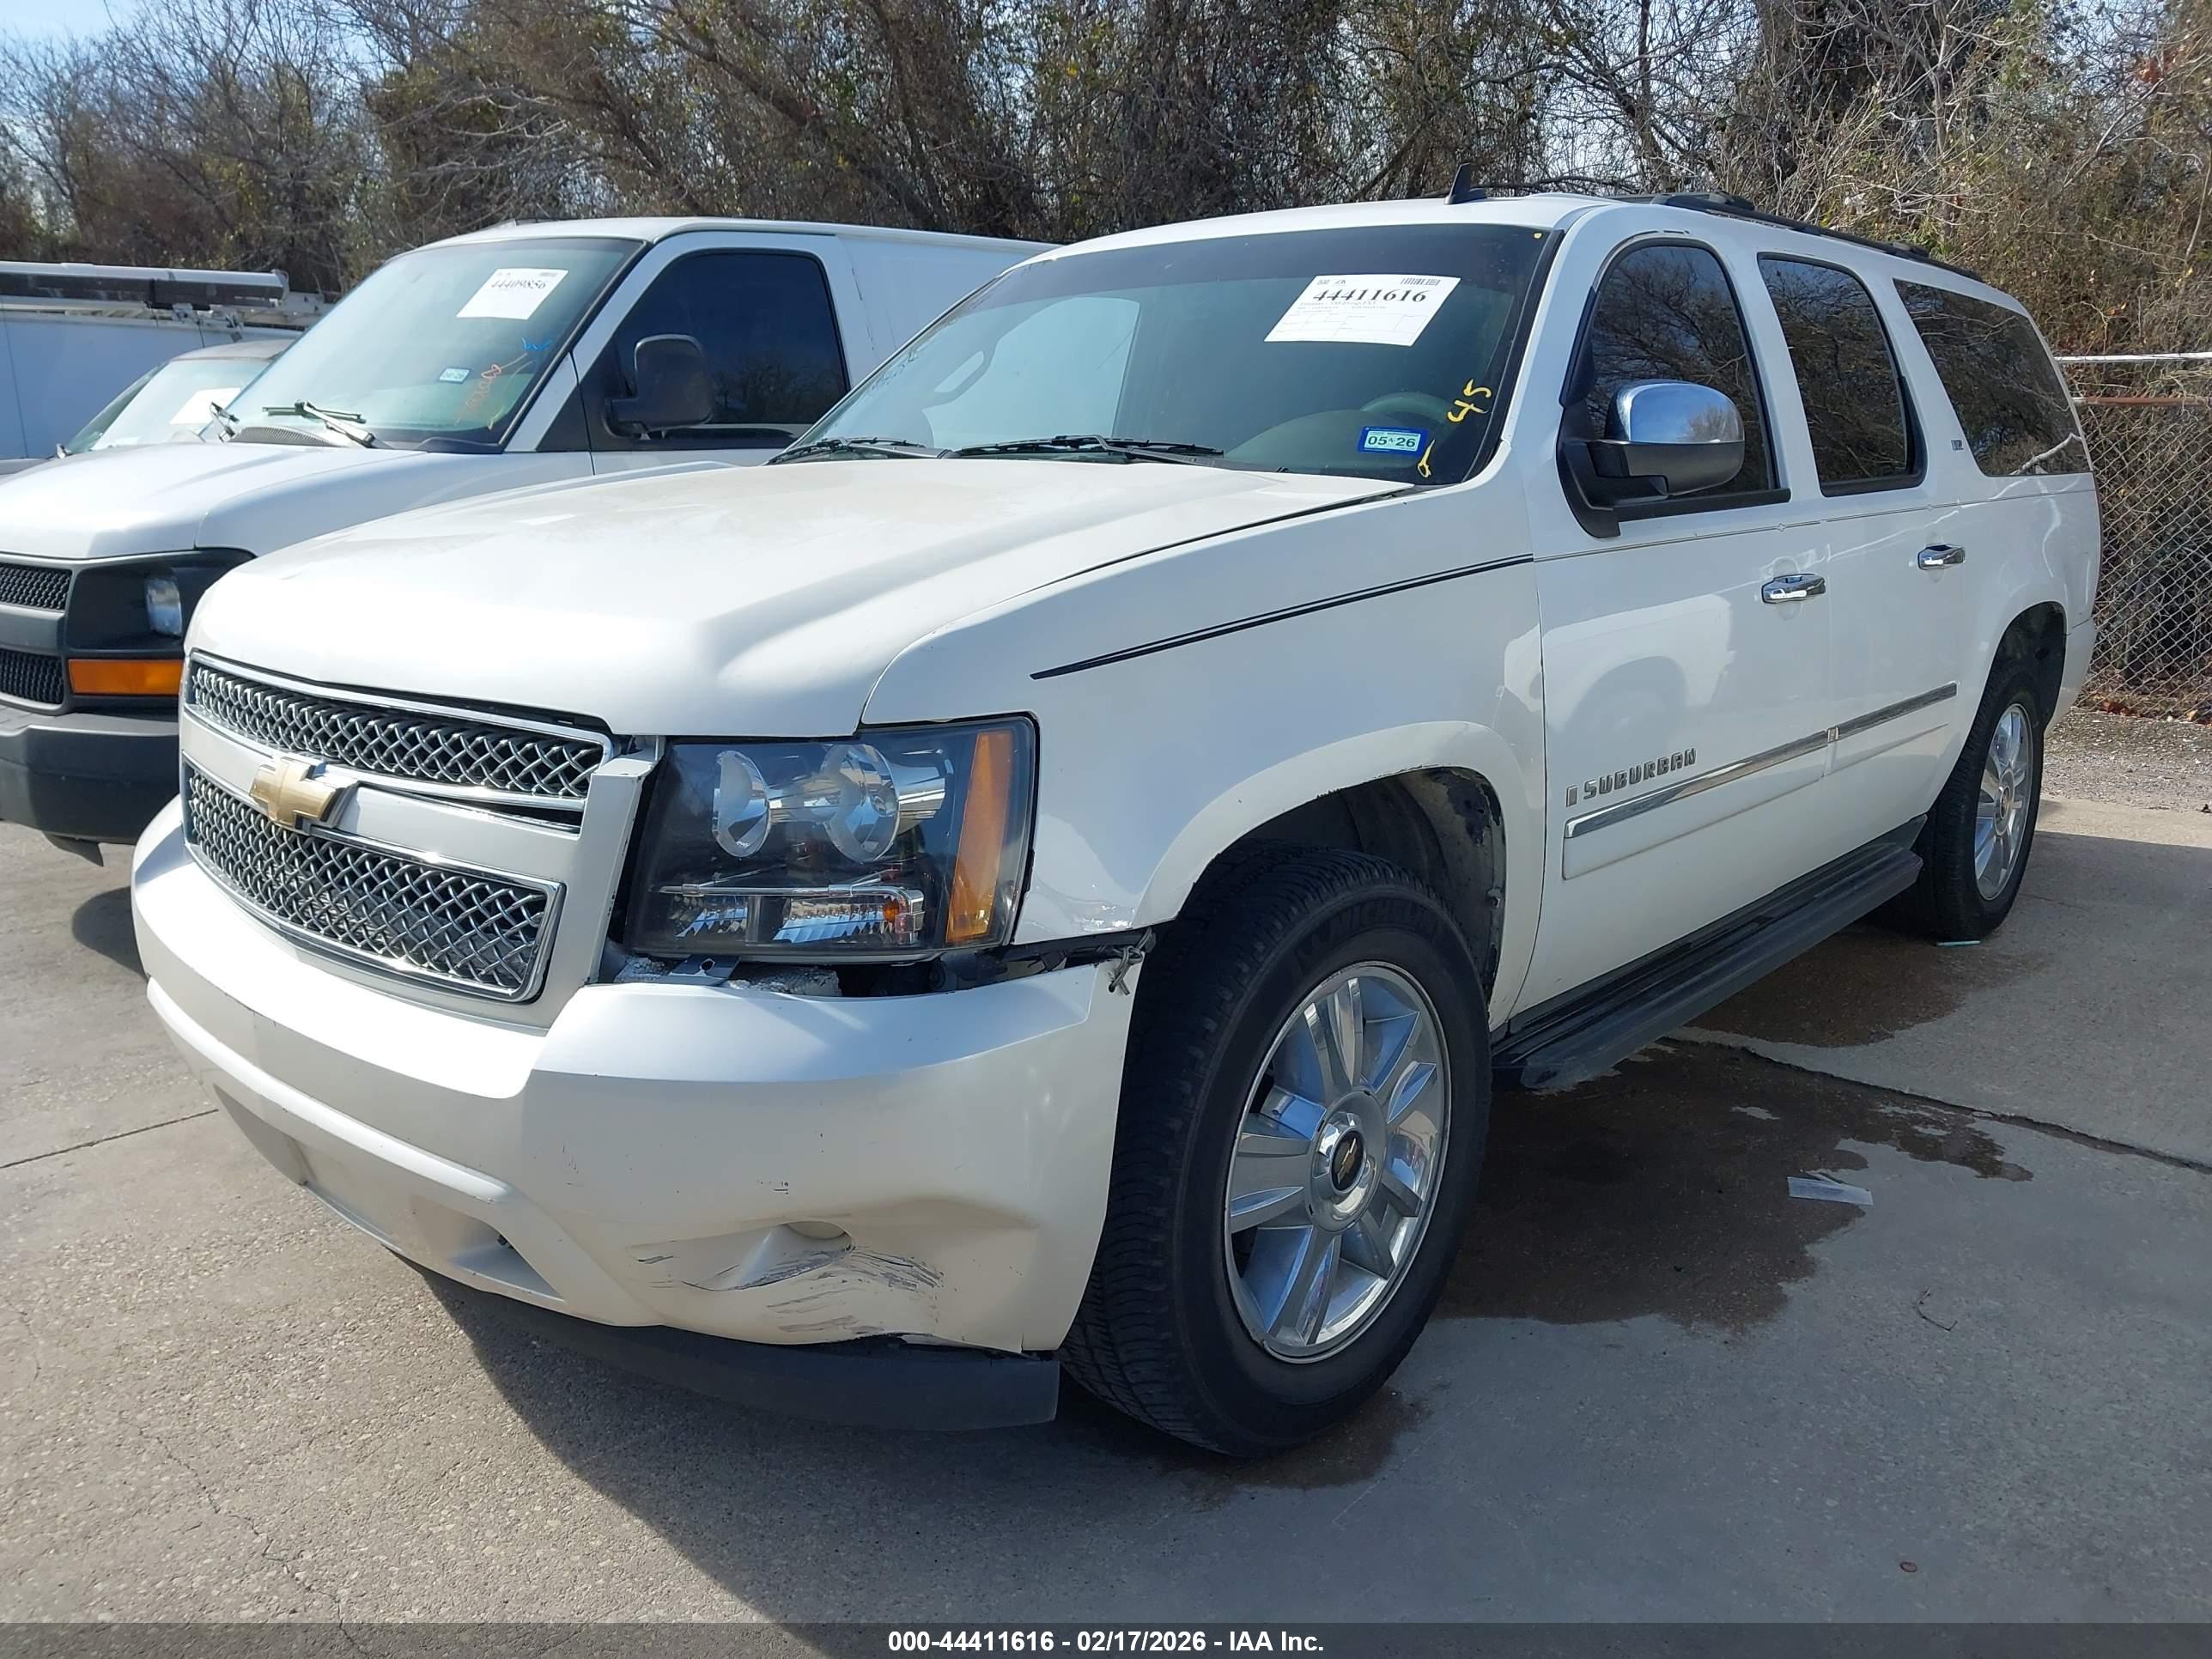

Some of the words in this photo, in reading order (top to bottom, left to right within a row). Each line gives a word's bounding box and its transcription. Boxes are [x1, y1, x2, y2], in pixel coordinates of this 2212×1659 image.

[1314, 289, 1429, 302] 44411616
[1367, 435, 1389, 446] 05
[1395, 437, 1417, 447] 26
[1583, 747, 1697, 800] SUBURBAN
